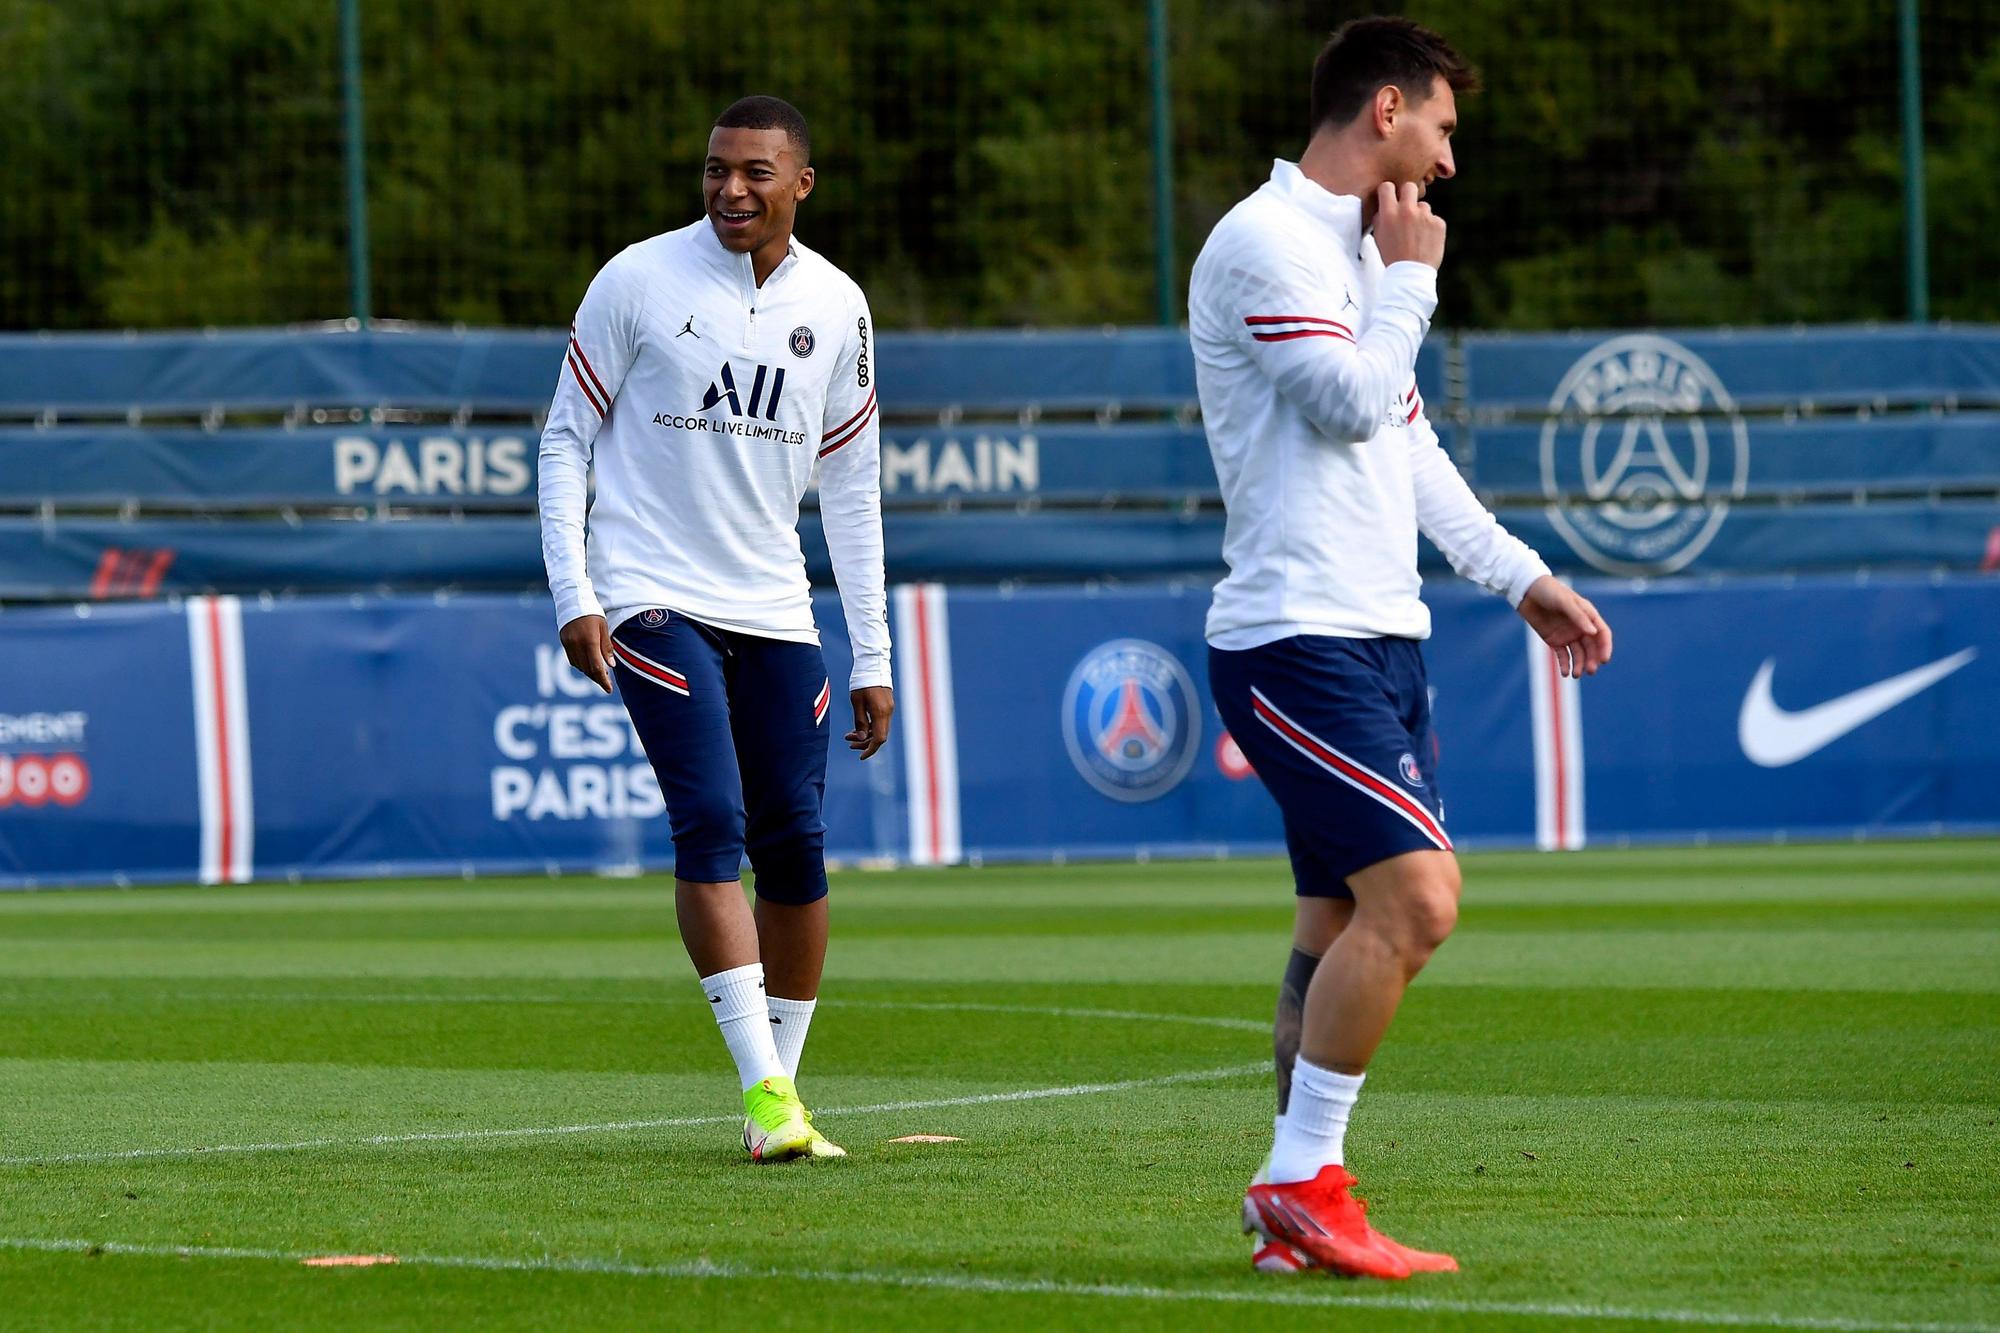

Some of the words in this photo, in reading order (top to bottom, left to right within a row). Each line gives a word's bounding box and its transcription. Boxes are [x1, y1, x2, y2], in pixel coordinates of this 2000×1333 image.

[1574, 351, 1703, 415] PARIS
[652, 412, 708, 431] ACCOR
[712, 420, 742, 435] LIVE
[745, 424, 806, 445] LIMITLESS
[334, 436, 531, 495] PARIS
[536, 644, 608, 698] IC
[491, 764, 667, 820] PARIS
